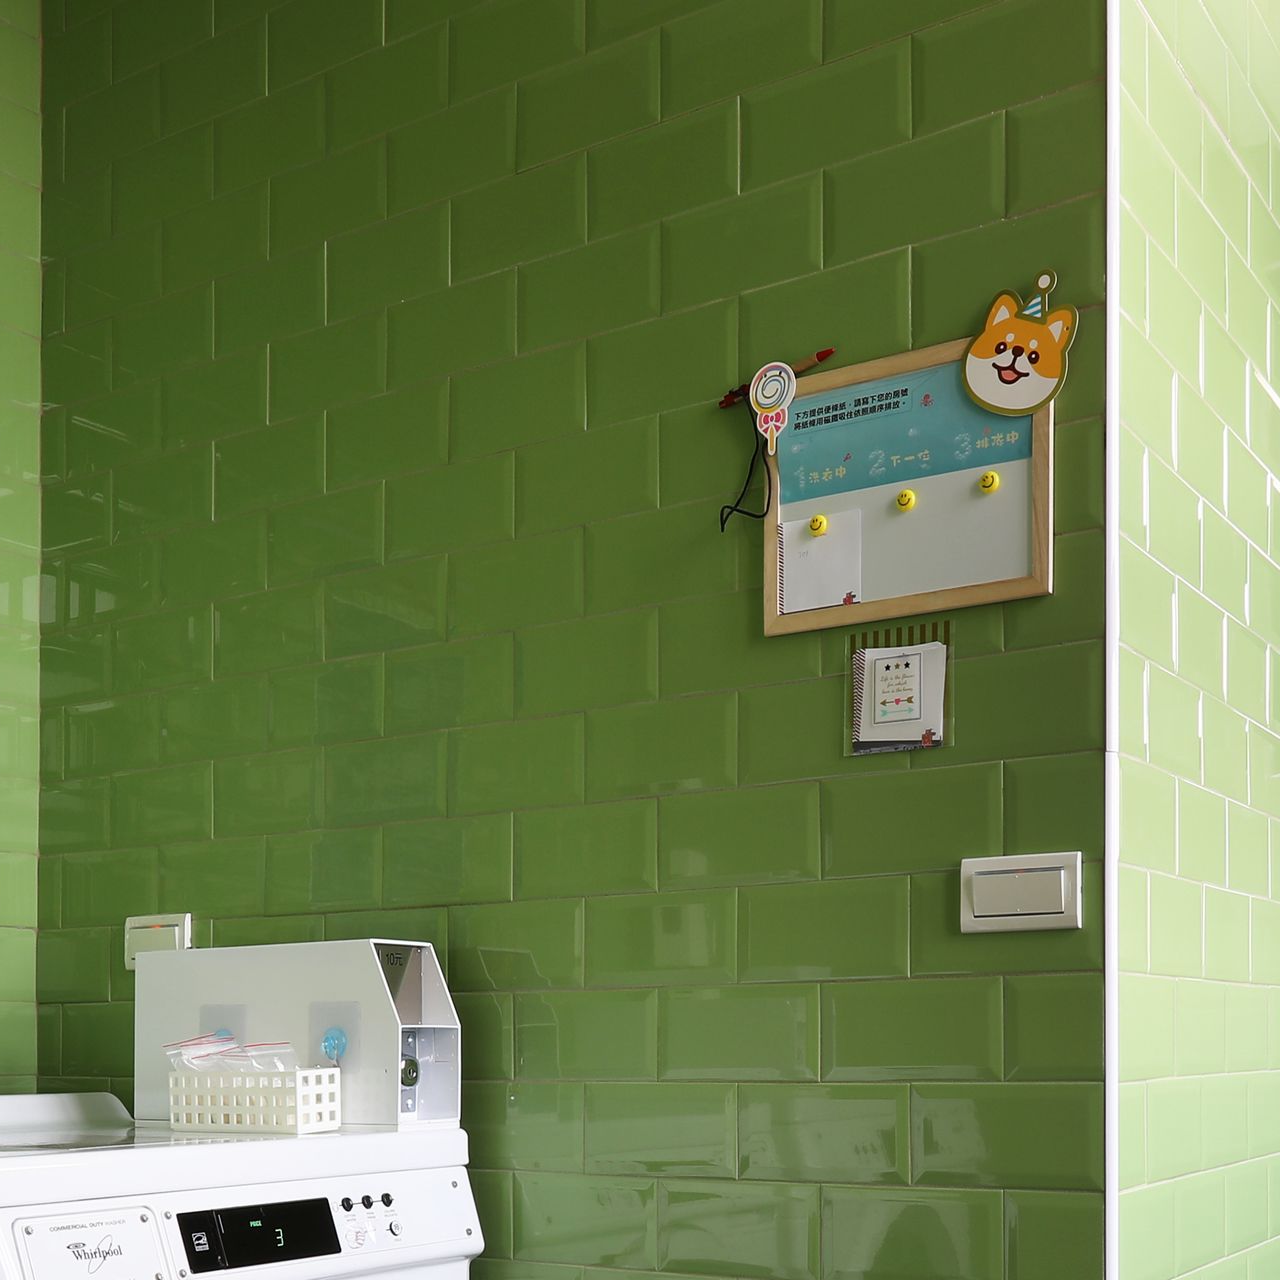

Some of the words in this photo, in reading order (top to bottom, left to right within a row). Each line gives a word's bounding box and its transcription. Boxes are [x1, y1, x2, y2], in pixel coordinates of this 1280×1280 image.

[385, 952, 404, 967] 10元
[48, 1223, 88, 1233] COMMERCIAL
[89, 1221, 104, 1229] DUTY
[275, 1228, 285, 1247] 3
[71, 1243, 123, 1261] Whirlpool
